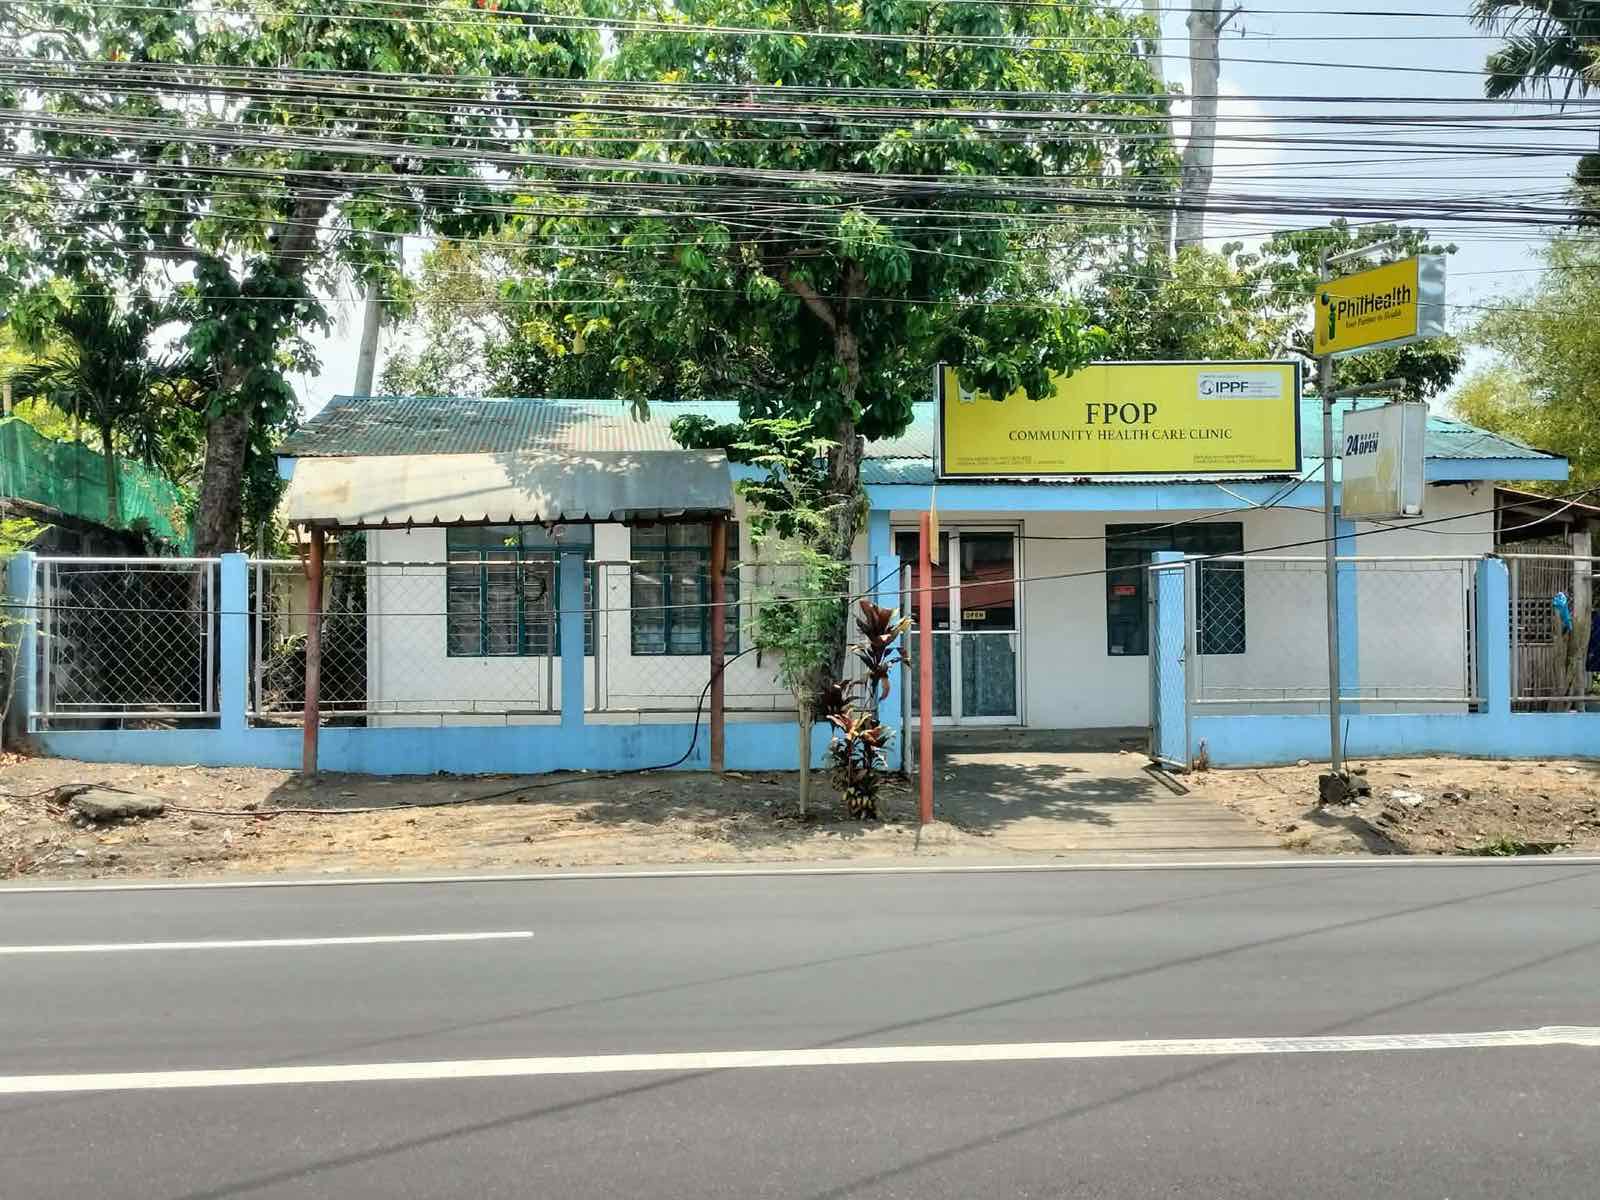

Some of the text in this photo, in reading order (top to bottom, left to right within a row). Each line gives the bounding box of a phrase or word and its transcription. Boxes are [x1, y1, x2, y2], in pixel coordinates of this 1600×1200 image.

[1337, 284, 1411, 320] PhilHealth
[1215, 381, 1249, 393] IPPF
[1085, 402, 1158, 425] FPOP
[1008, 428, 1232, 441] COMMUNITY HEALTH CARE CLINIC
[1345, 434, 1359, 456] 24
[1358, 439, 1378, 455] OPEN
